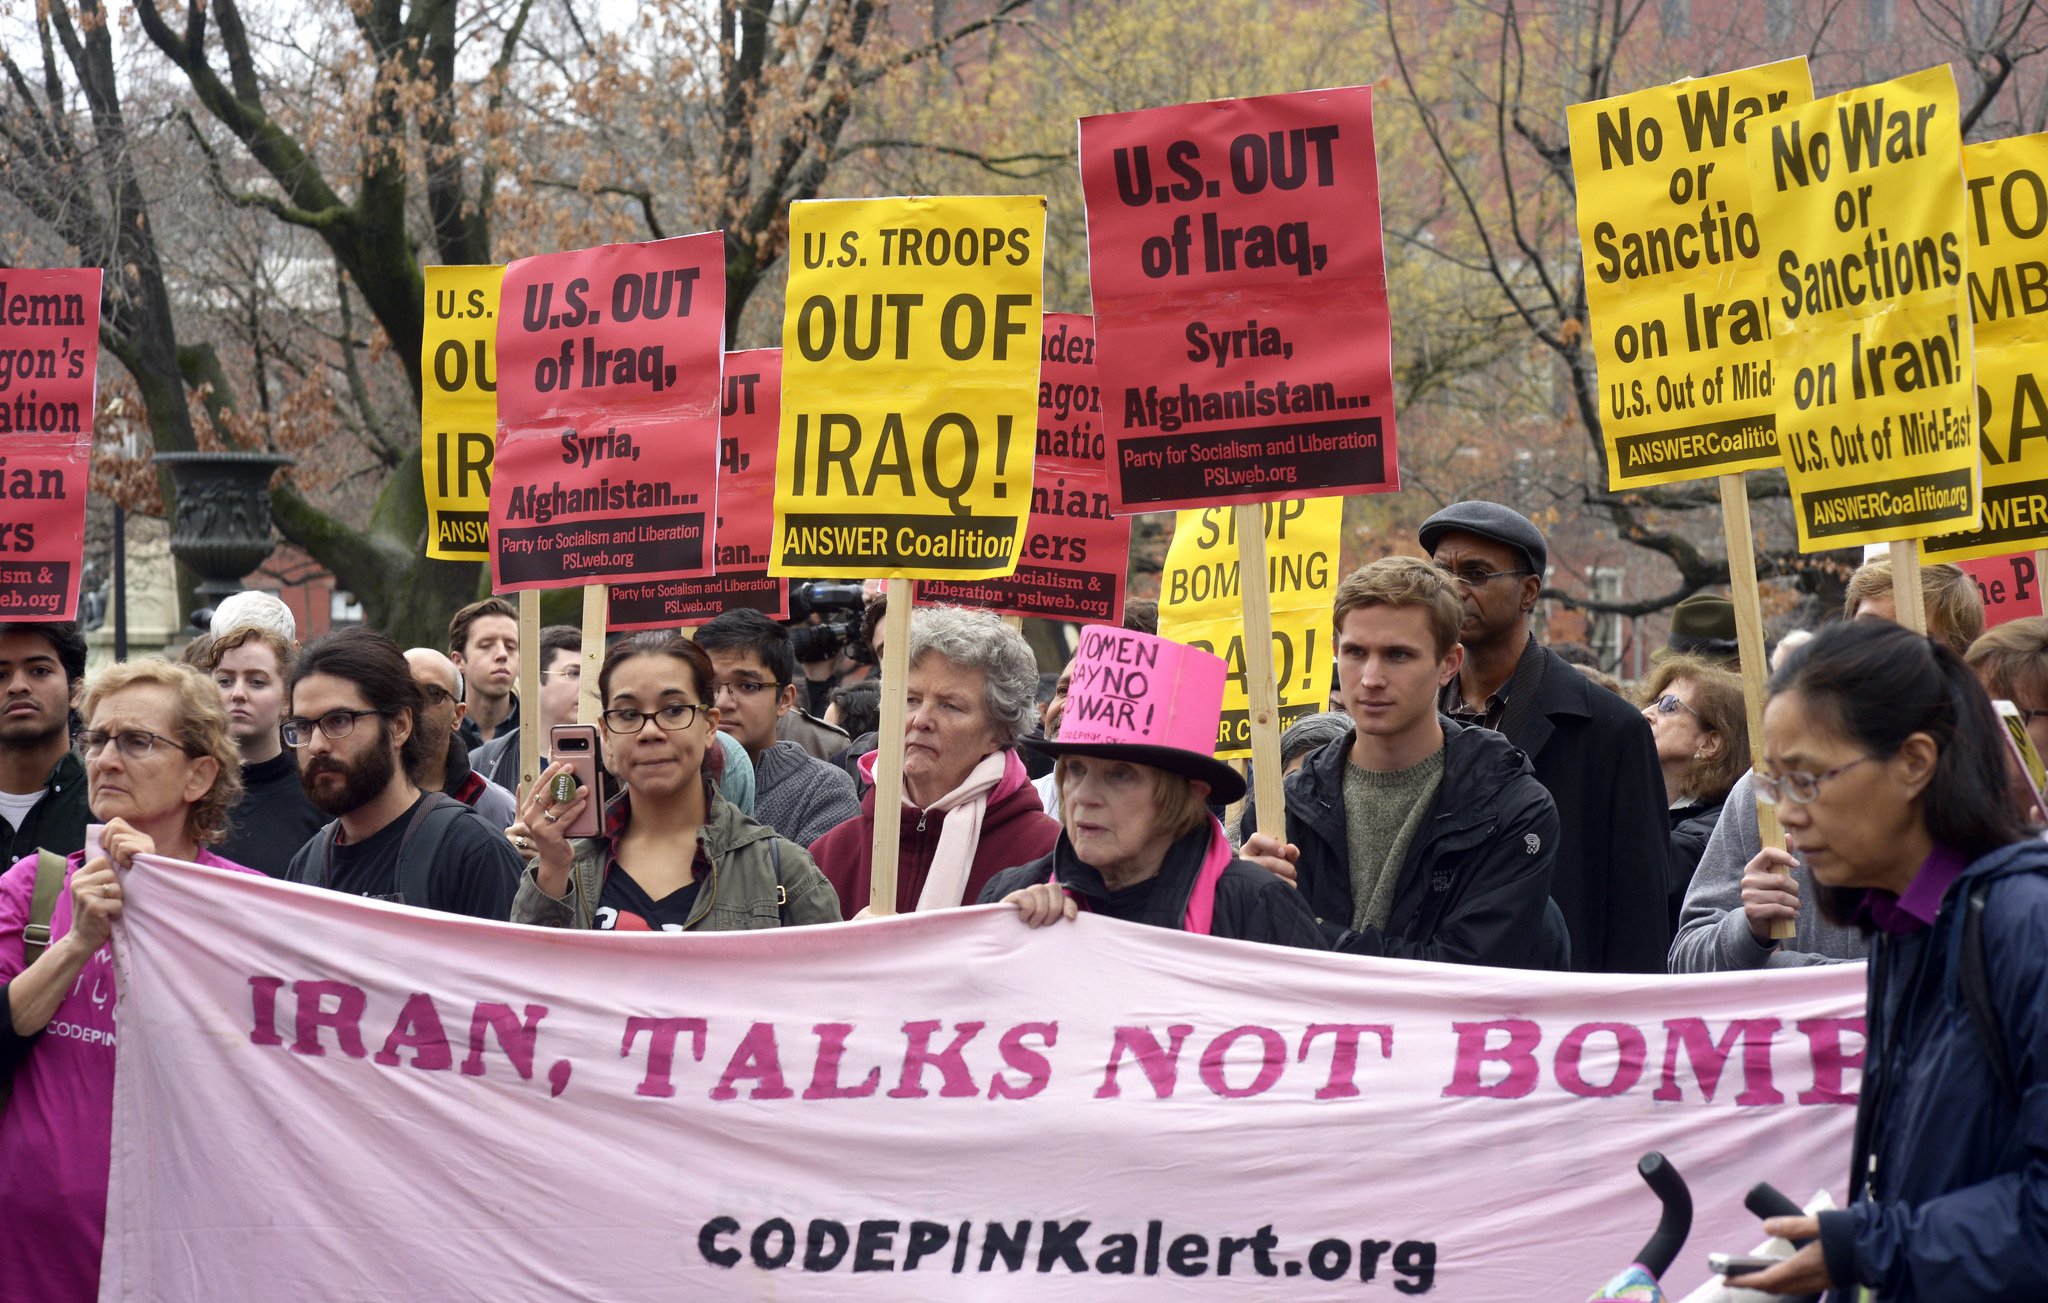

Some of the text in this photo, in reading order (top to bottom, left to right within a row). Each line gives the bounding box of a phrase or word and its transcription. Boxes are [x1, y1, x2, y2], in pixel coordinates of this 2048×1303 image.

[1597, 107, 1663, 171] No
[1772, 97, 1937, 192] No War
[1113, 124, 1340, 207] U.S. OUT
[1669, 162, 1715, 206] or
[1835, 184, 1873, 233] or
[803, 227, 1030, 269] U.S. TROOPS
[1141, 211, 1328, 278] of Iraq,
[1594, 200, 1760, 284] Sanctio
[1778, 227, 1962, 320] Sanctions
[437, 289, 493, 319] U.S.
[523, 267, 700, 332] U.S. OUT
[797, 293, 1032, 362] OUT OF
[1185, 320, 1293, 368] Syria,
[1614, 292, 1772, 364] on Ira
[535, 337, 677, 393] of Iraq,
[1794, 314, 1962, 411] on Iran!
[1124, 380, 1370, 432] Afghanistan...
[1611, 378, 1652, 420] U.S.
[1656, 372, 1696, 413] Out
[1702, 366, 1724, 406] of
[561, 428, 640, 468] Syria,
[1124, 431, 1377, 469] Party for Socialism and Liberation
[1628, 425, 1777, 467] ANSWERCoalitio
[1788, 405, 1971, 474] U.S. Out of Mid-East
[791, 412, 1013, 516] IRAQ!
[1204, 463, 1297, 487] PSLweb.org
[506, 478, 698, 523] Afghanistan...
[1196, 499, 1306, 550] SP
[1814, 485, 1967, 526] ANSWERCoalition.org
[502, 525, 699, 554] Party for Socialism and Liberation
[563, 551, 634, 570] PSLweb.org
[783, 526, 1013, 558] ANSWER Coalition
[1020, 534, 1087, 563] ers
[38, 566, 53, 584] &
[612, 578, 776, 601] Party for Socialism and Liberation
[923, 579, 1109, 616] Liberation pslweb.org
[1088, 576, 1100, 591] &
[1169, 551, 1328, 606] BOMING
[665, 599, 722, 614] PSLweb.org
[1101, 666, 1148, 699] NO
[247, 975, 572, 1098] IRAN,
[620, 1016, 1058, 1100] TALKS
[1093, 1023, 1394, 1100] NOT
[697, 1215, 1437, 1296] CODEPINKalert.org
